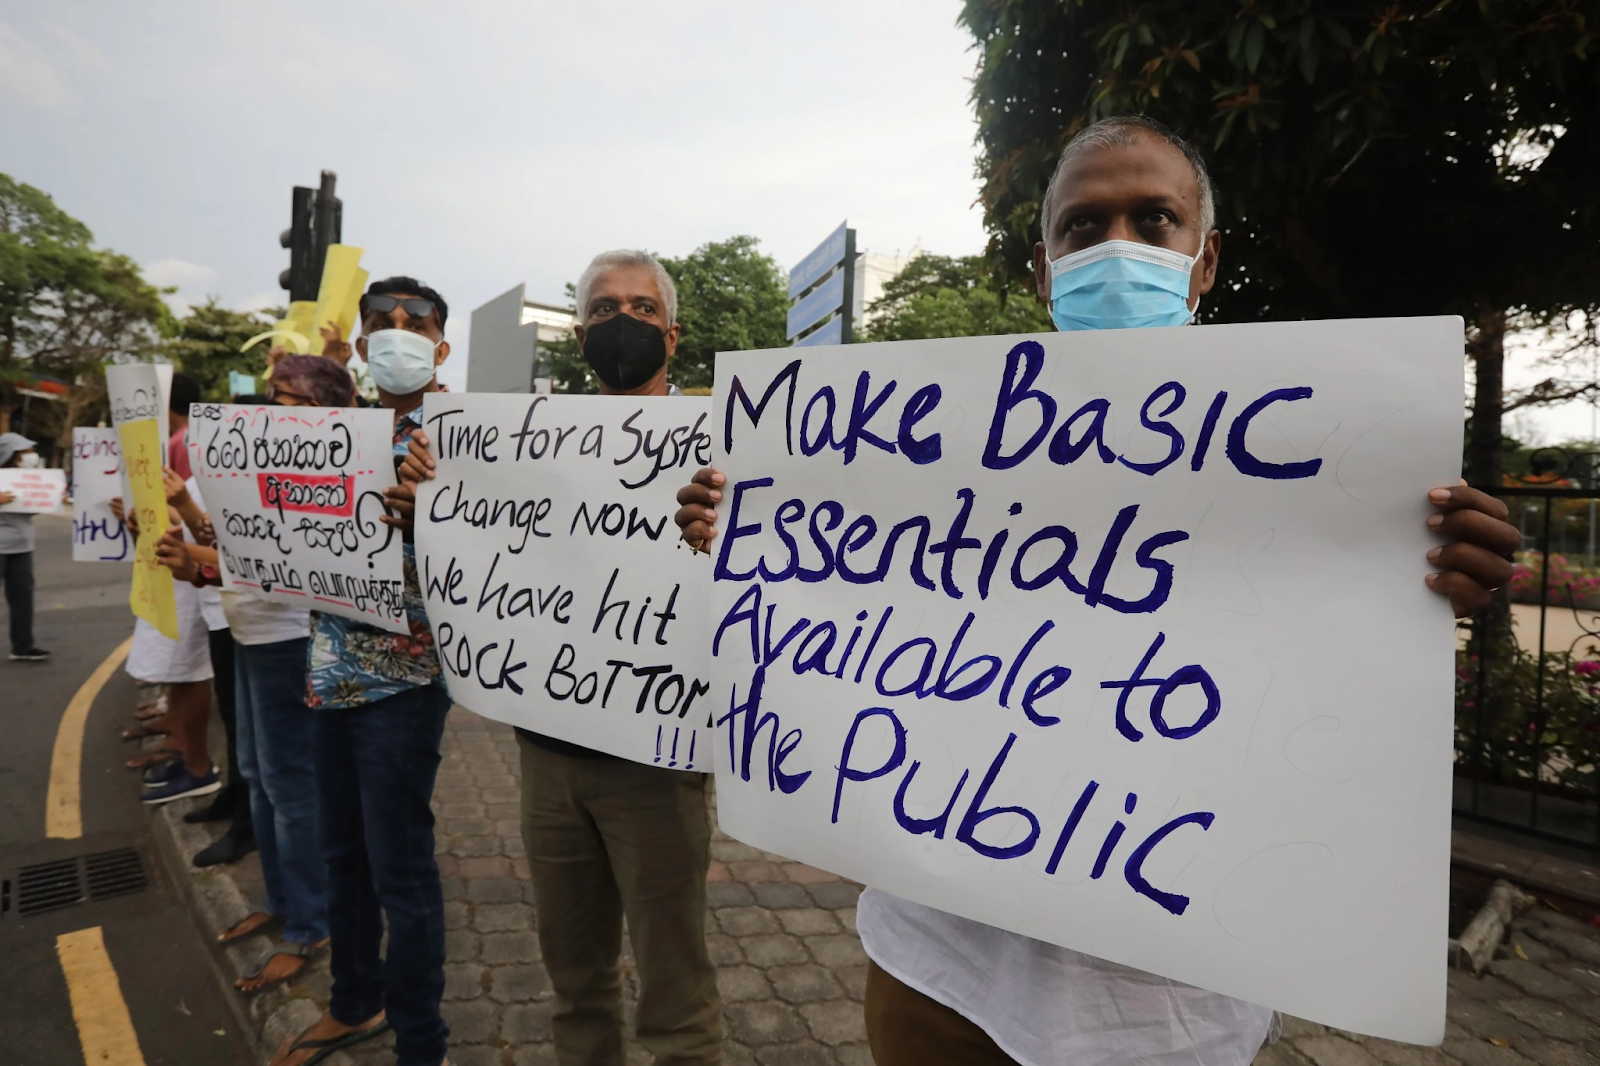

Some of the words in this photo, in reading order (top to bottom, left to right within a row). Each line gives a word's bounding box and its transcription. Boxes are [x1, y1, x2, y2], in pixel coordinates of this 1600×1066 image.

[509, 396, 577, 462] for
[579, 424, 604, 458] a
[613, 409, 712, 489] Syste
[723, 359, 943, 465] Make
[429, 480, 552, 554] Change
[713, 477, 1190, 614] Essentials
[425, 555, 468, 606] We
[476, 552, 574, 625] have
[592, 567, 681, 645] hit
[712, 584, 1072, 727] Available
[1100, 632, 1222, 742] to
[653, 723, 697, 770] !!!
[716, 664, 812, 794] the
[830, 706, 1215, 916] Public
